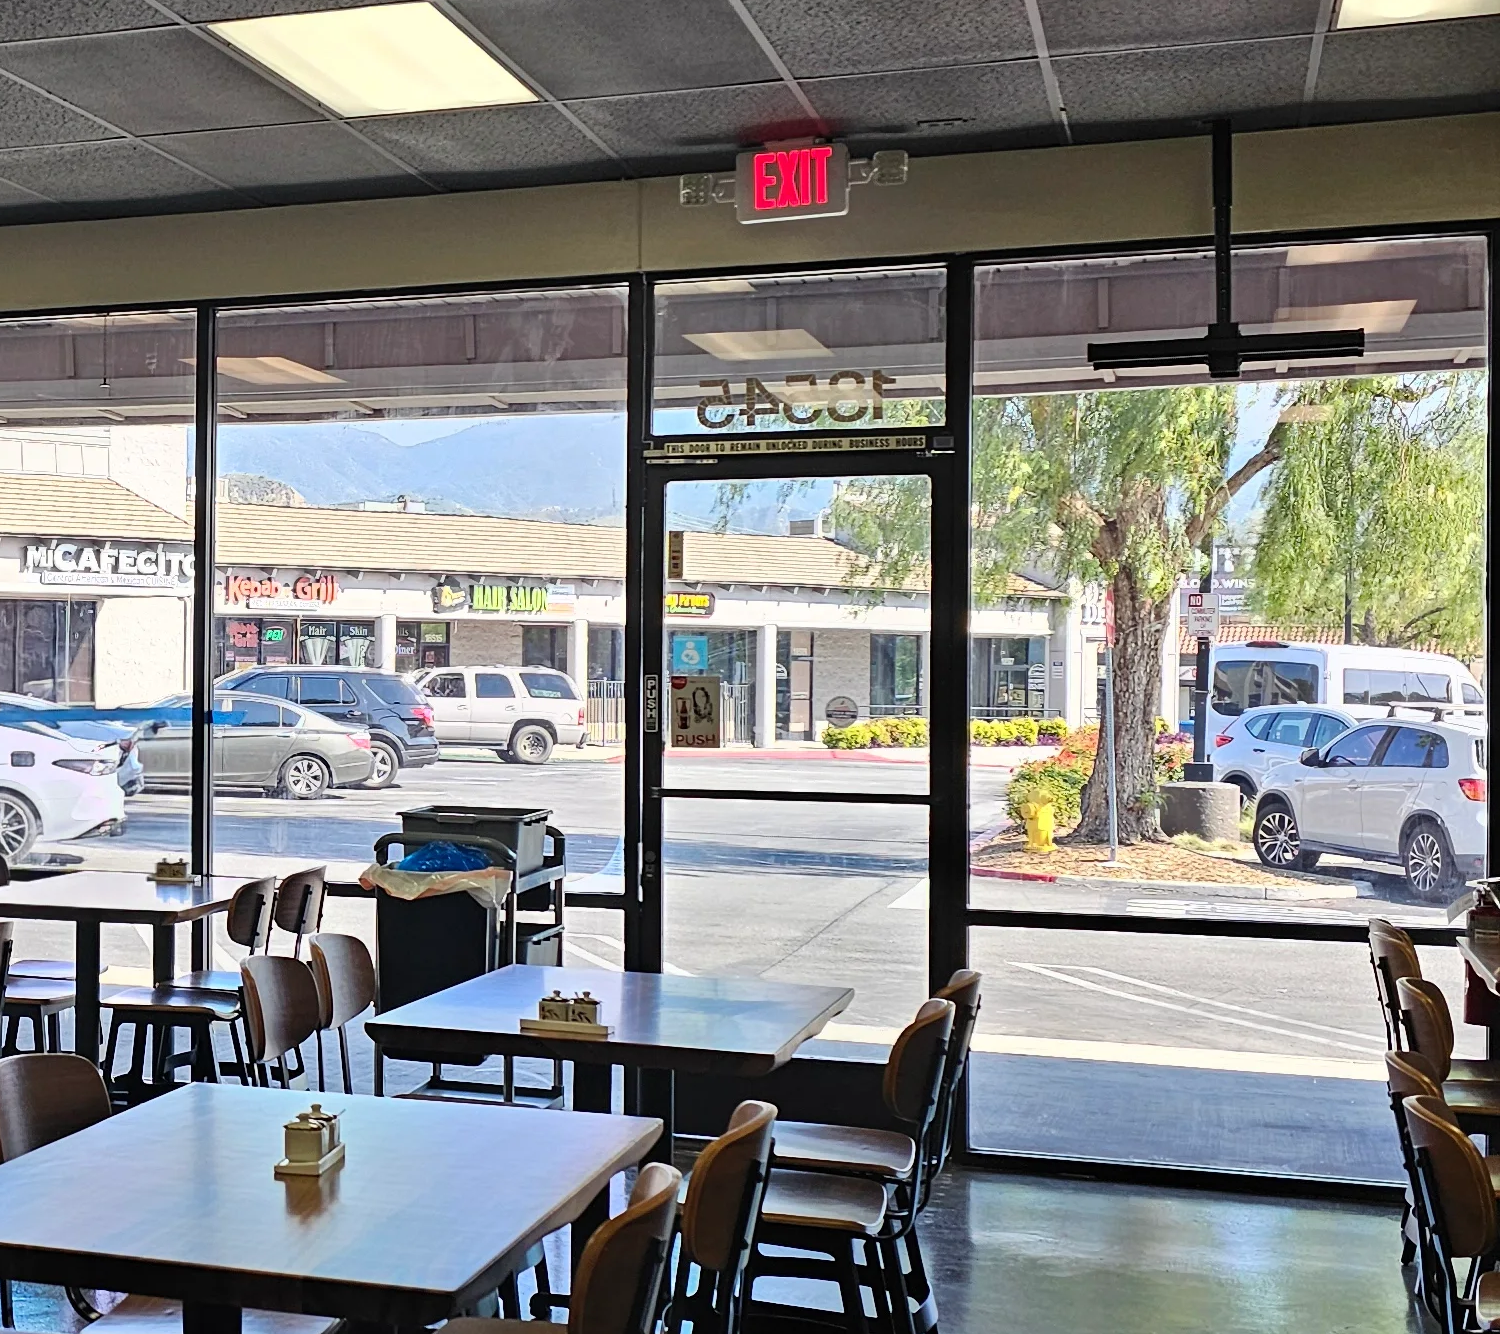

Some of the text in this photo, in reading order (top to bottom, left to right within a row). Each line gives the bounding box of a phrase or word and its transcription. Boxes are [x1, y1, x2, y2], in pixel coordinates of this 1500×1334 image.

[754, 147, 832, 210] EXIT
[667, 436, 924, 454] THIS DOOR TO REMAIN UNLOCKED DURING BUSINESS HOURS
[227, 575, 340, 604] Kebab Grill
[472, 585, 507, 611] HAIR
[509, 585, 547, 612] SALON
[1190, 595, 1202, 606] NO
[349, 626, 368, 636] Skin
[647, 680, 656, 718] PUSH
[676, 733, 716, 746] PUSH
